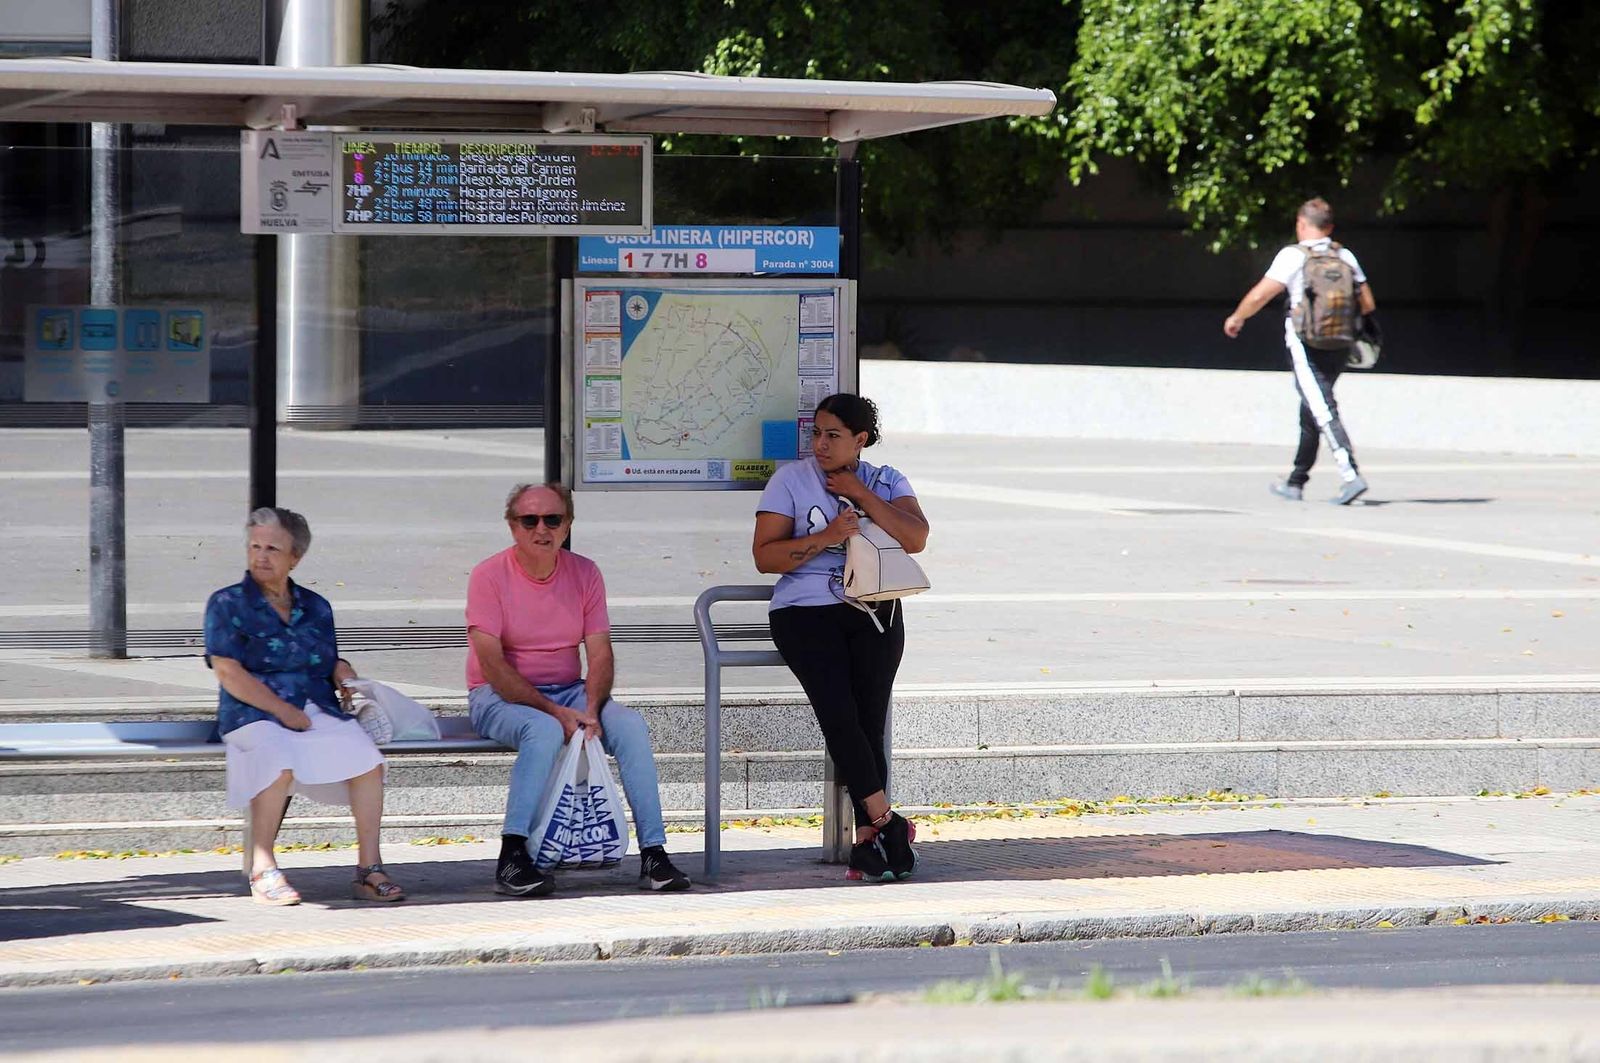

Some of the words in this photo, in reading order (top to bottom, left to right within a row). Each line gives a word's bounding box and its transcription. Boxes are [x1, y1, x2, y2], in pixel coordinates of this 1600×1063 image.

[393, 142, 441, 154] TIEMPO
[391, 161, 414, 173] bus
[418, 162, 432, 173] 14
[436, 162, 458, 173] min
[460, 162, 508, 174] Barriada
[511, 162, 528, 174] del
[532, 163, 577, 174] Carmen
[391, 173, 414, 184] bus
[436, 173, 458, 184] min
[460, 174, 493, 187] Diego
[495, 174, 576, 187] Sayago-Orden
[346, 185, 373, 197] 7HP
[384, 185, 398, 197] 28
[402, 186, 450, 197] minutos
[460, 186, 519, 199] Hospitales
[391, 198, 414, 209] bus
[436, 198, 458, 209] min
[460, 199, 506, 212] Hospital
[509, 200, 535, 211] Juan
[538, 199, 579, 211] Ramón
[581, 199, 625, 212] Jiménez
[260, 219, 298, 227] HUELVA
[346, 210, 373, 221] 7HP
[391, 210, 414, 222] bus
[417, 210, 432, 222] 58
[436, 211, 458, 222] min
[460, 211, 519, 224] Hospitales
[718, 229, 814, 249] (HIPERCOR)
[624, 252, 633, 269] 1
[642, 252, 654, 269] 7
[661, 252, 688, 269] 7H
[695, 252, 708, 269] 8
[762, 260, 796, 269] Parada
[811, 260, 834, 269] 3004
[679, 468, 701, 476] parada
